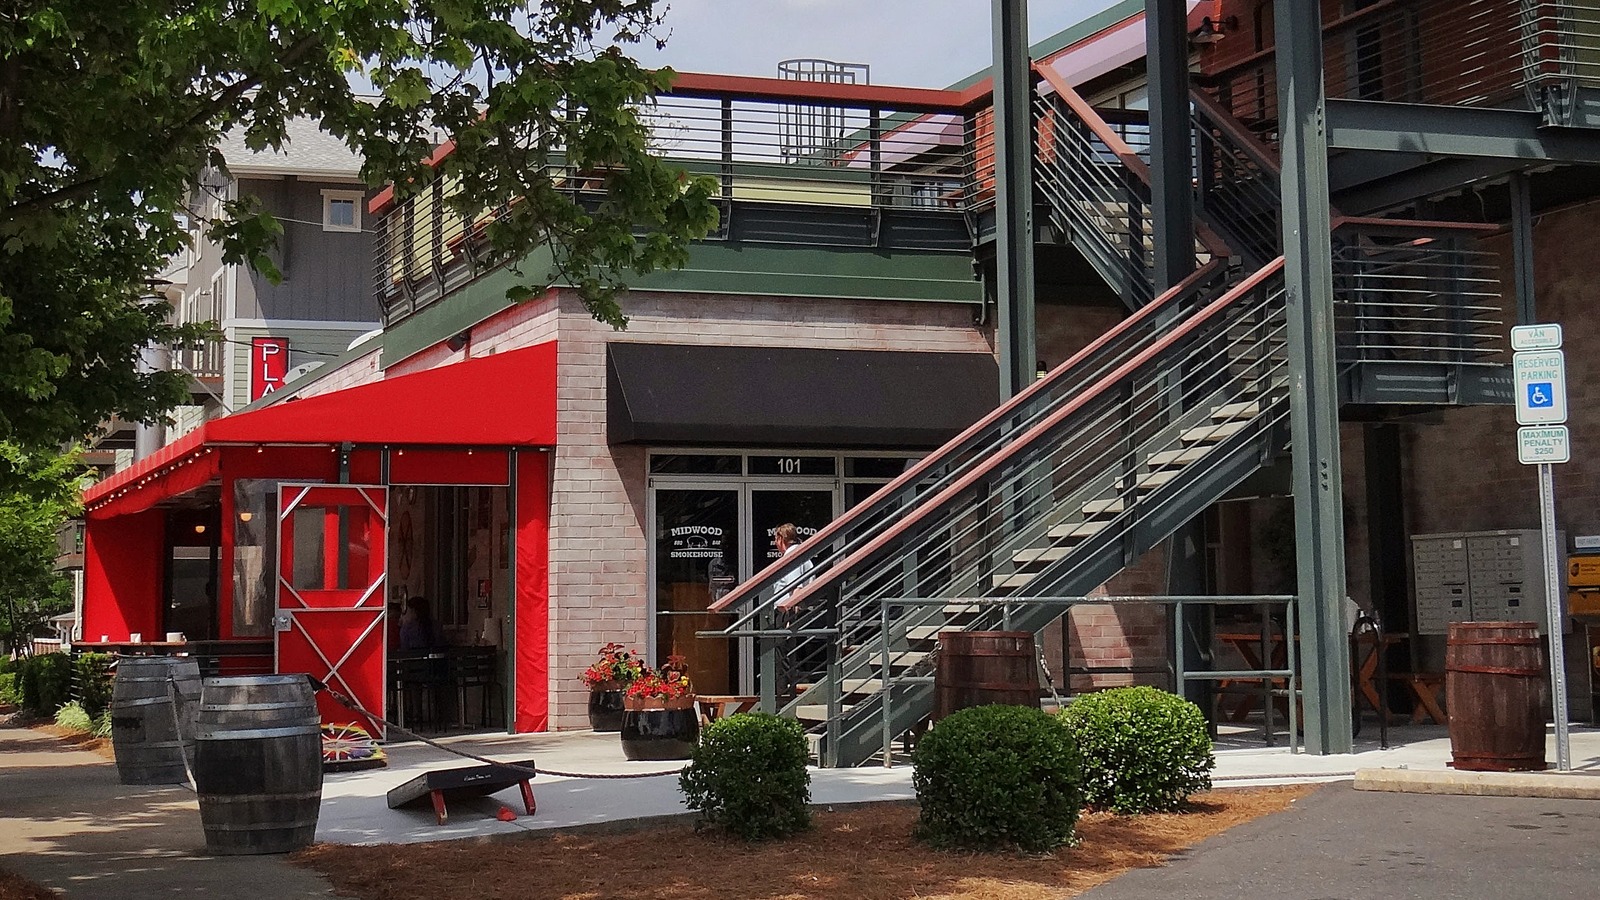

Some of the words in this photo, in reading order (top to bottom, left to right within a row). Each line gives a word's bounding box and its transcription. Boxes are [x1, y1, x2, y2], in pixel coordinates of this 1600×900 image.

[1528, 329, 1545, 338] VAN
[1518, 358, 1560, 368] RESERVED
[1521, 370, 1558, 380] PARKING
[1523, 430, 1564, 439] MAXIMUM
[1524, 439, 1563, 447] PENALTY
[777, 458, 801, 474] 101
[670, 526, 723, 537] MIDWOOD
[766, 526, 818, 537] MOOD
